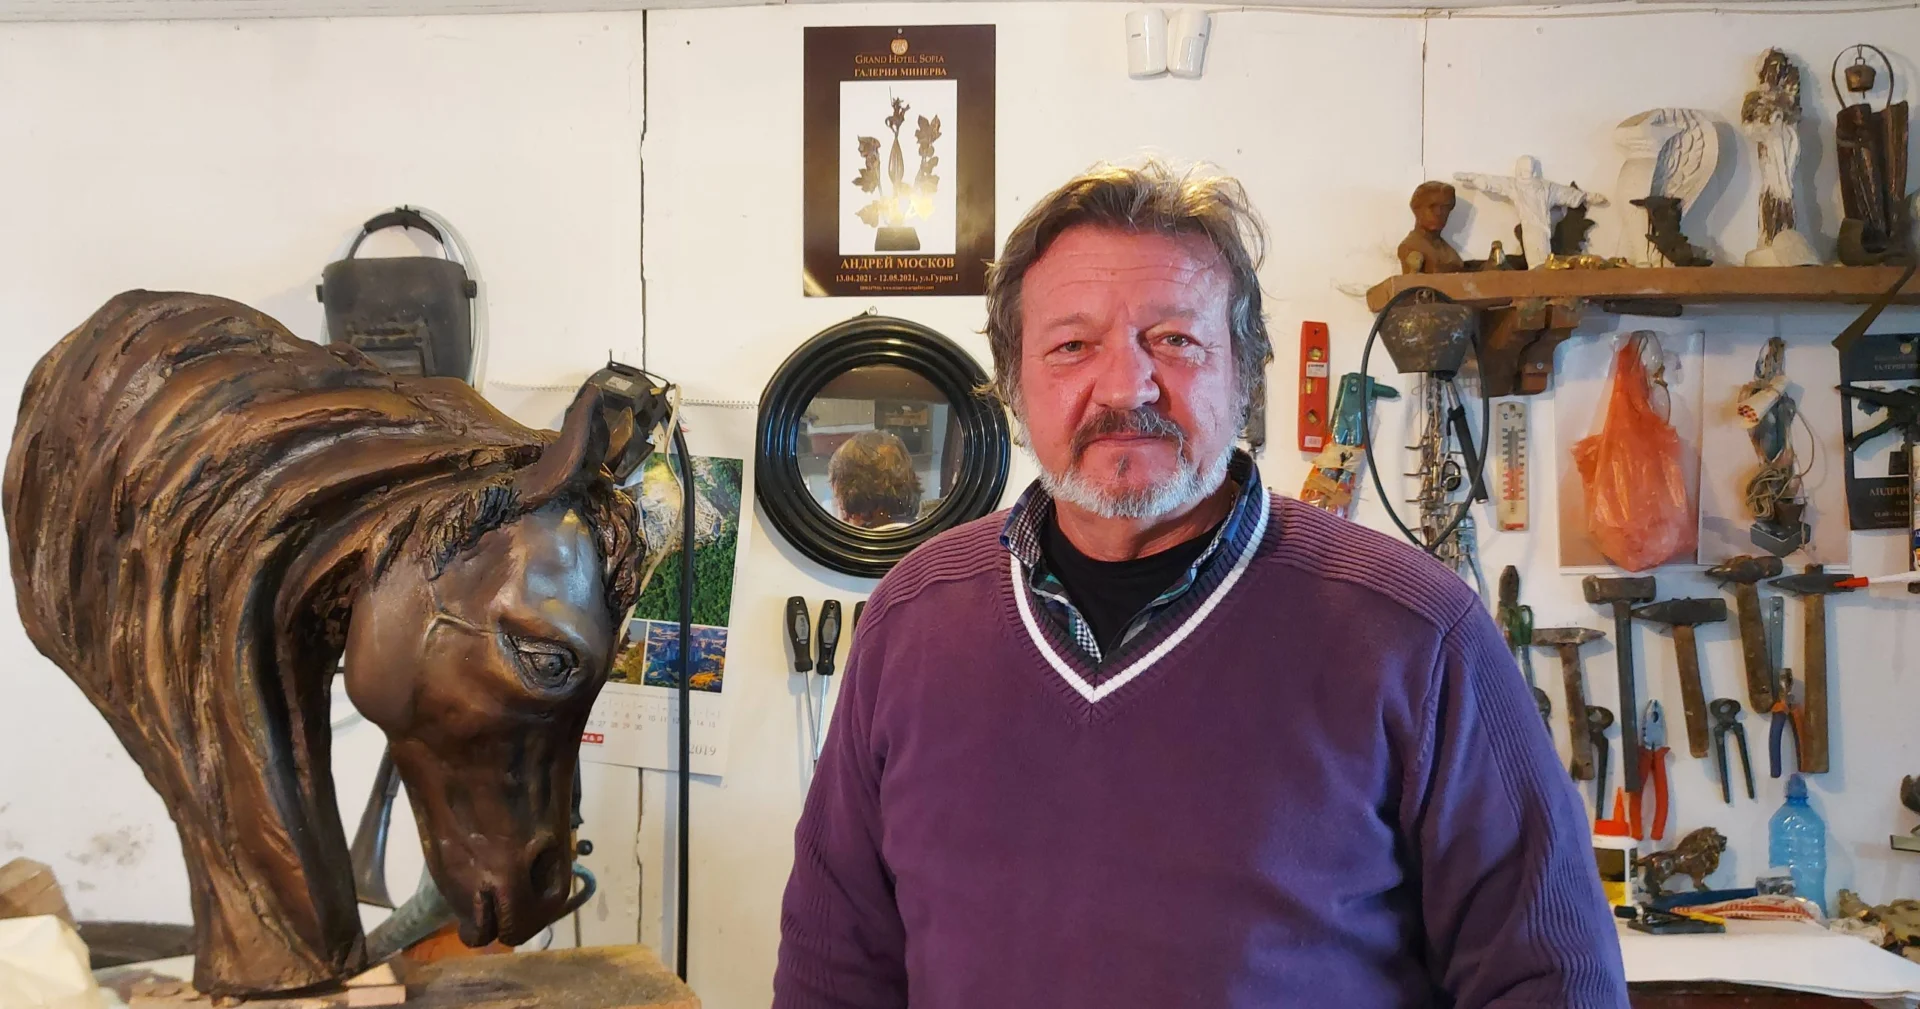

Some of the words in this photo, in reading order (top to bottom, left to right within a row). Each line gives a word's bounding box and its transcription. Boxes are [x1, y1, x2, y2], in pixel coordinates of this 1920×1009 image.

[855, 54, 887, 64] GRAND
[889, 54, 917, 64] HOTEL
[919, 53, 945, 63] SOFIA
[854, 68, 898, 77] ГАЛЕРИЯ
[900, 67, 947, 76] МИНЕРВА
[841, 256, 894, 270] АНДРЕЙ
[897, 257, 955, 269] МОСКОВ
[836, 274, 872, 283] 13.04.2021
[689, 743, 717, 756] 2019
